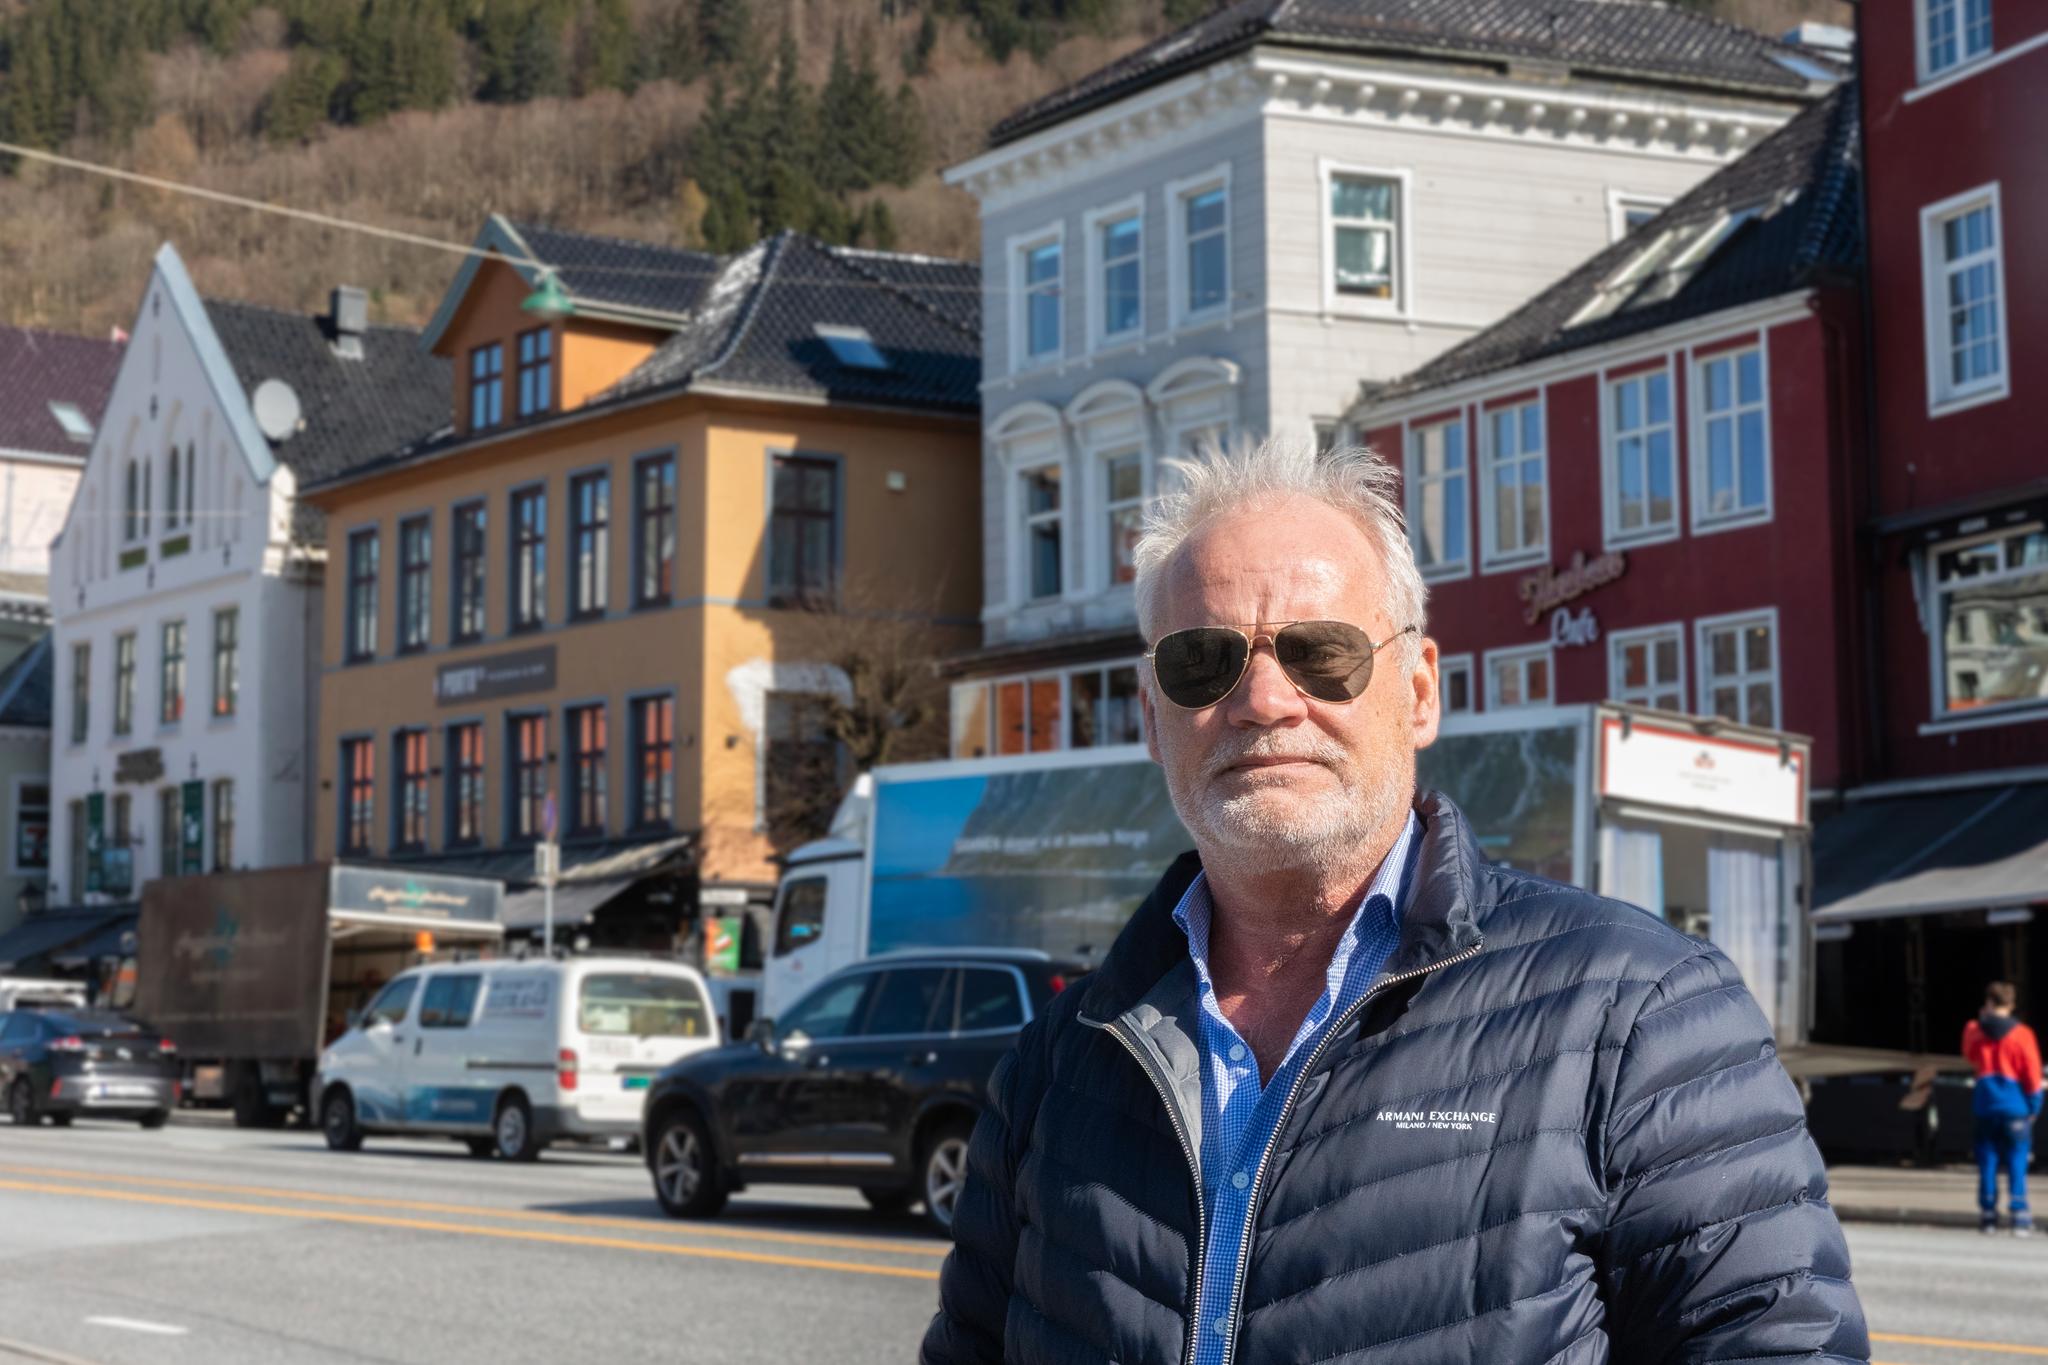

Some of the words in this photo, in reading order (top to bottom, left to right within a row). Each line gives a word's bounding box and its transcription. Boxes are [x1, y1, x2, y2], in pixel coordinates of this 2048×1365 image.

[1376, 1111, 1424, 1121] ARMANI
[1429, 1111, 1496, 1123] EXCHANGE
[1451, 1122, 1472, 1130] YORK
